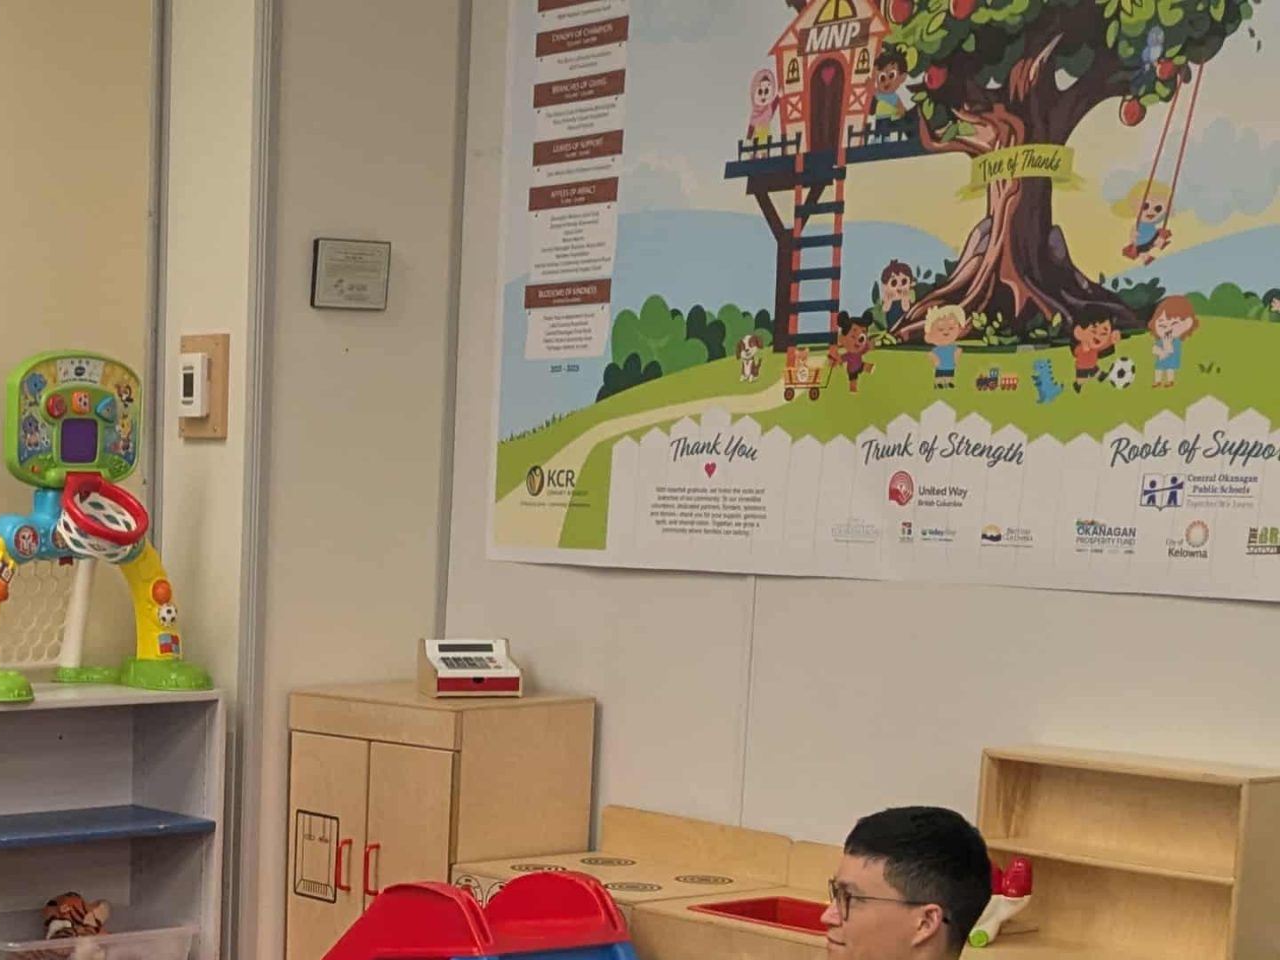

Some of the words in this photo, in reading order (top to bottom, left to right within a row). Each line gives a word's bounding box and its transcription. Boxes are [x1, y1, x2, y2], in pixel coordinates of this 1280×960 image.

[806, 22, 859, 52] MNP
[979, 158, 1002, 181] Tree
[1006, 156, 1017, 179] of
[1021, 149, 1060, 171] Thanks
[670, 433, 722, 462] Thank
[724, 435, 758, 461] You
[862, 435, 913, 465] Trunk
[919, 434, 935, 462] of
[940, 433, 1024, 467] Strength
[1110, 435, 1171, 467] Roots
[1178, 433, 1201, 464] of
[547, 469, 575, 488] KCR
[1187, 475, 1216, 483] Central
[1218, 475, 1258, 484] Okanagan
[918, 486, 947, 497] United
[949, 487, 968, 499] Way
[1192, 485, 1217, 494] Public
[1220, 486, 1250, 494] Schools
[1077, 527, 1136, 537] OKANAGAN
[1168, 548, 1208, 558] Kelowna
